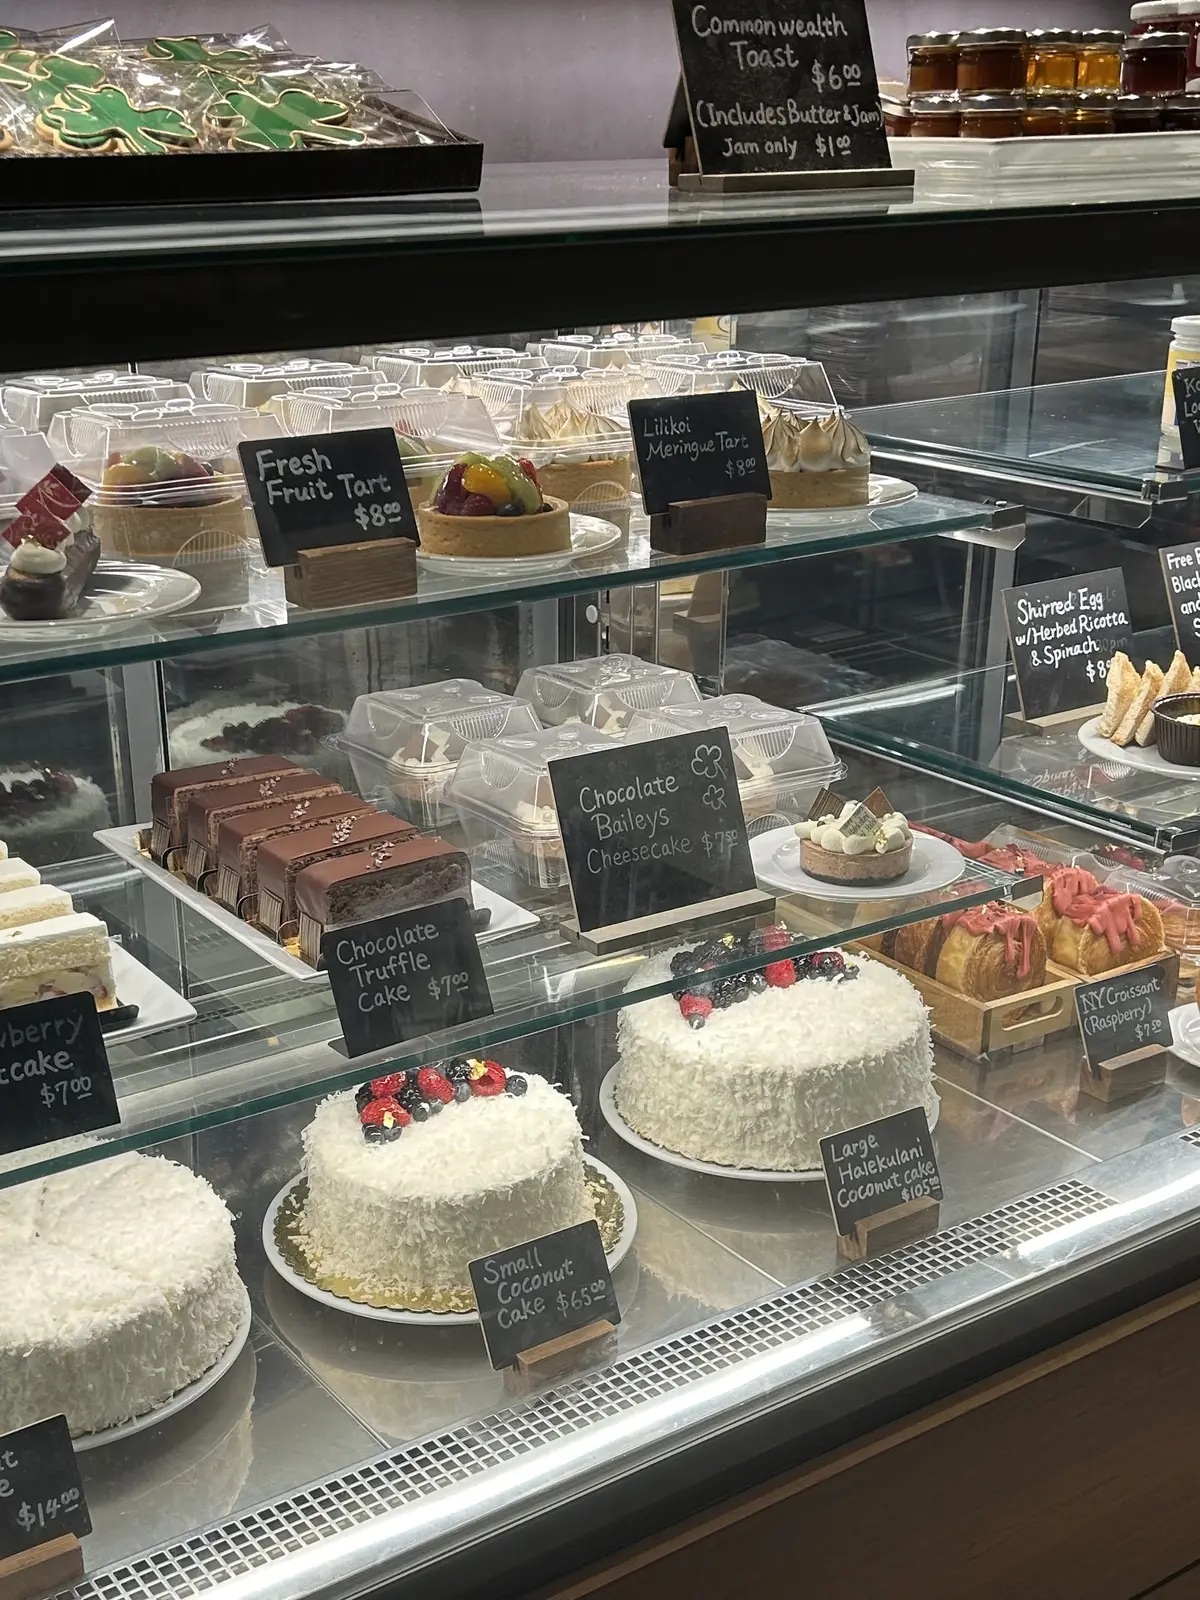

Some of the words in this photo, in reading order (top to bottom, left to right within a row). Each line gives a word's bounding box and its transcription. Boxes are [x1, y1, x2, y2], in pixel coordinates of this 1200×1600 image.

[729, 40, 800, 71] Toast
[787, 98, 842, 125] Butter
[722, 137, 760, 157] Jam
[765, 138, 797, 160] only
[644, 416, 691, 437] Lilikoi
[646, 439, 716, 462] Meringue
[715, 431, 749, 451] Tart
[256, 448, 332, 481] Fresh
[266, 478, 333, 505] Fruit
[337, 473, 392, 499] Tart
[1166, 552, 1194, 571] Free
[1017, 591, 1075, 626] Shirred
[1078, 587, 1104, 611] Egg
[1078, 611, 1129, 634] Ricotta
[1031, 650, 1042, 667] &
[1043, 635, 1100, 669] Spinach
[579, 775, 680, 813] Chocolate
[591, 807, 670, 842] Baileys
[587, 836, 693, 874] Cheesecake
[336, 923, 440, 965] Chocolate
[349, 950, 431, 988] Truffle
[358, 983, 411, 1013] Cake
[1080, 986, 1106, 1015] NY
[1106, 977, 1161, 1006] Croissant
[1083, 996, 1152, 1036] (Raspberry)
[831, 1133, 879, 1163] Large
[838, 1137, 924, 1185] Halekulani
[836, 1172, 902, 1209] Coconut
[483, 1246, 543, 1285] Small
[496, 1258, 574, 1305] Coconut
